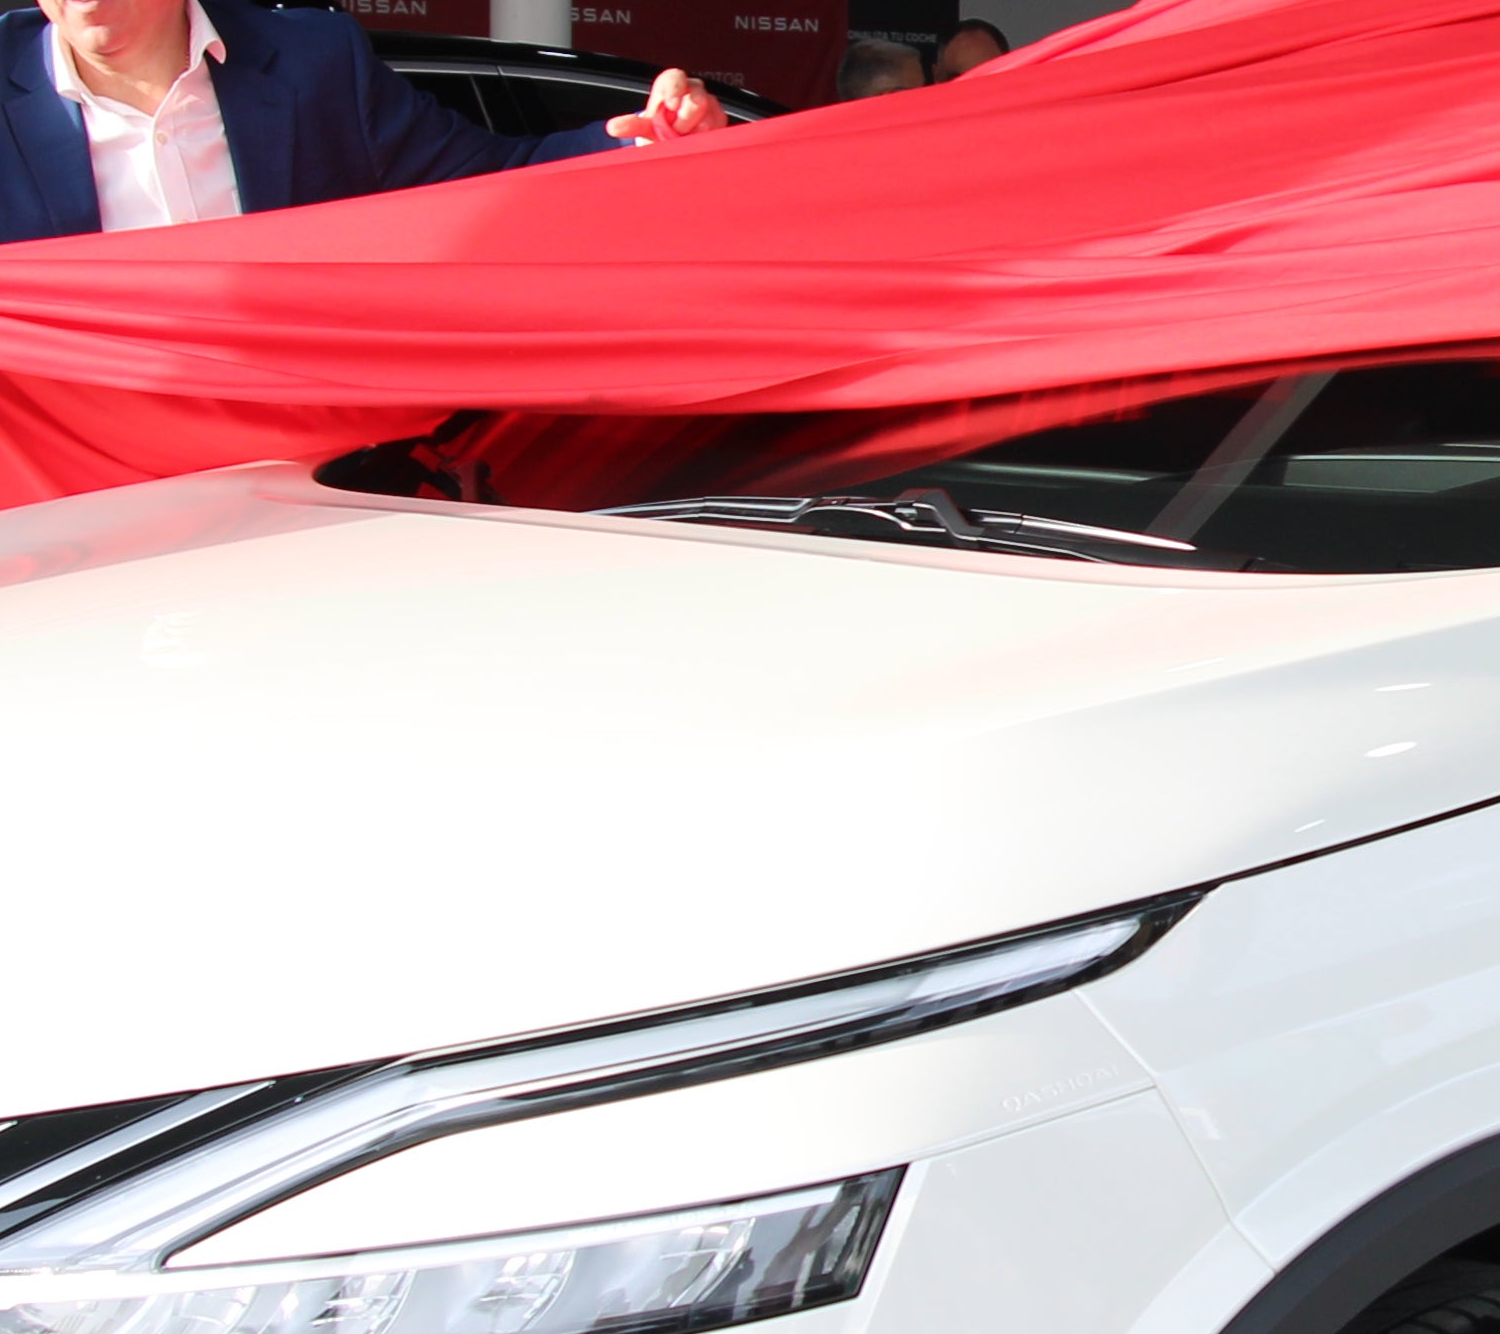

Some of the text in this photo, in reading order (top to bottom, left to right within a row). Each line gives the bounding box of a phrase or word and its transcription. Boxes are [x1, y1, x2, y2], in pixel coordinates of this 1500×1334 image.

[570, 7, 632, 25] SSAN
[734, 15, 819, 33] NISSAN
[905, 32, 938, 44] COCHE
